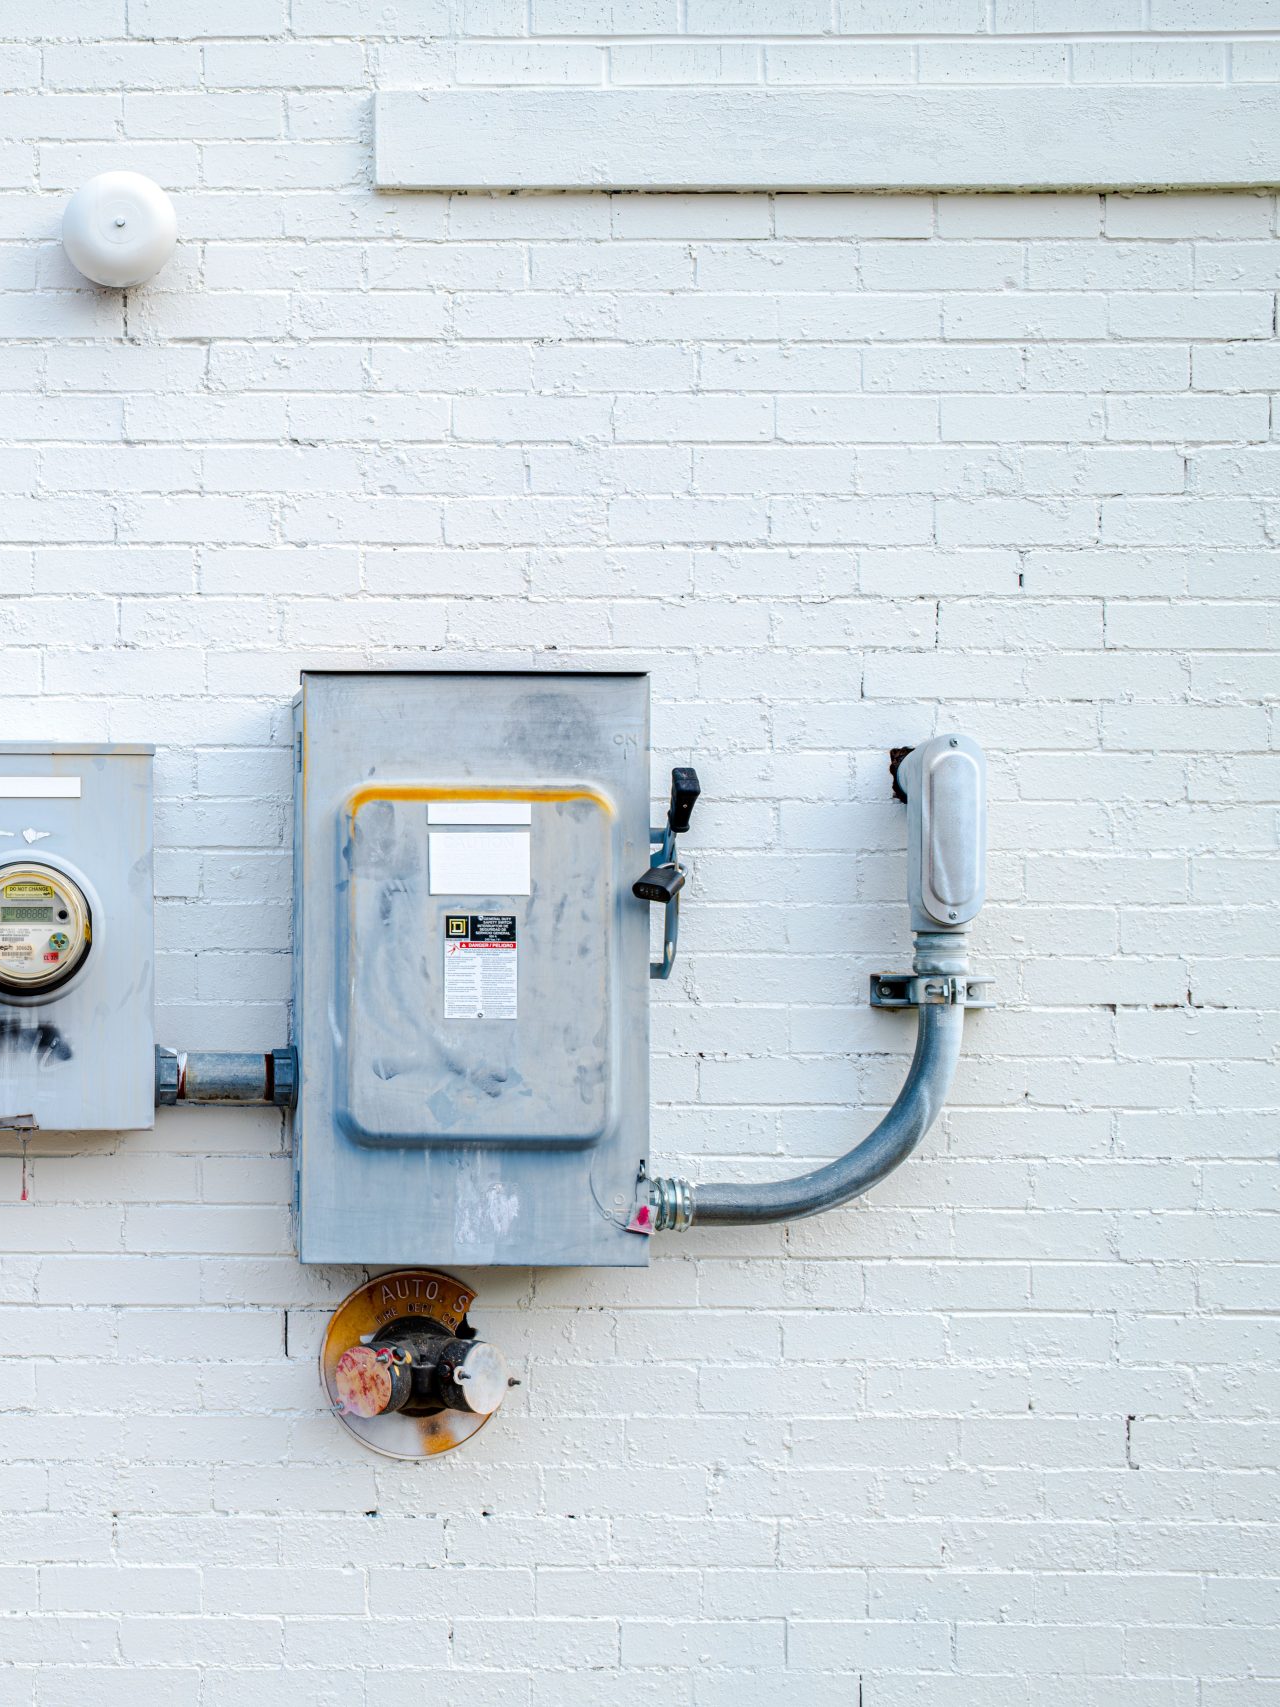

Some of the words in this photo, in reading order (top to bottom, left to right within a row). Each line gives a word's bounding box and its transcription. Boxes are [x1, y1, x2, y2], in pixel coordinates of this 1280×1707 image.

[612, 734, 638, 746] ON
[381, 1279, 444, 1305] AUTO.
[376, 1307, 399, 1325] FIRE
